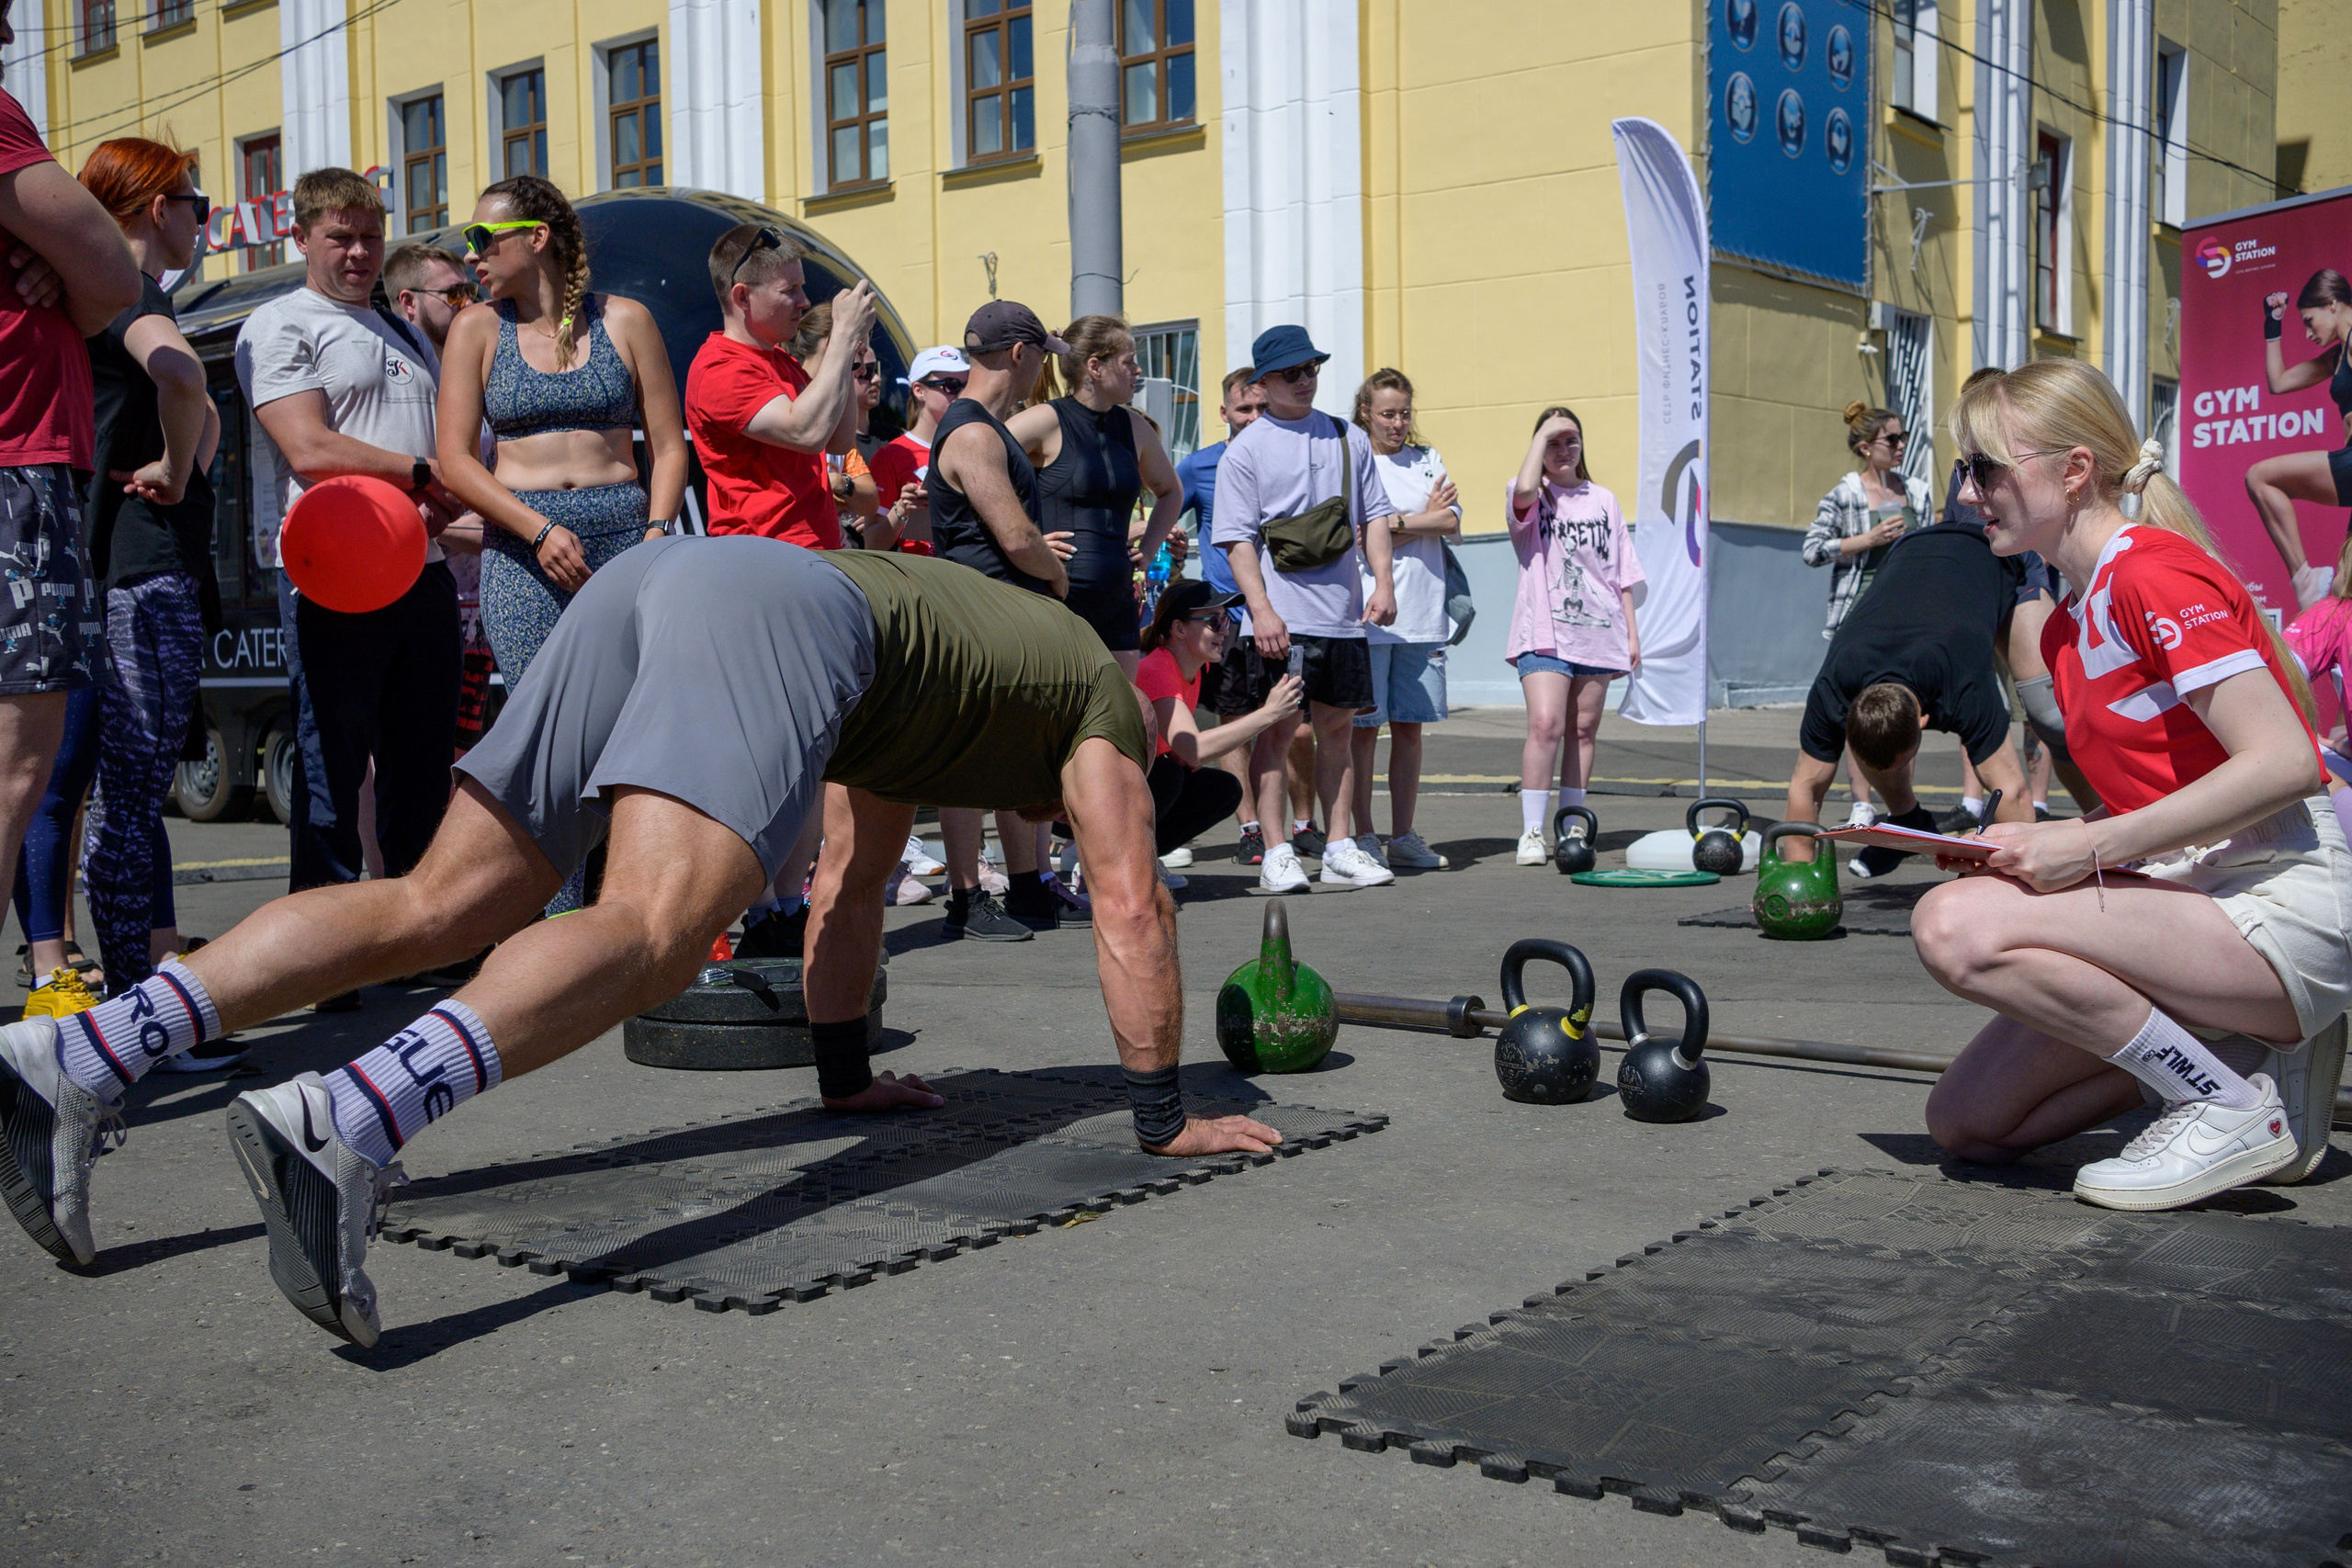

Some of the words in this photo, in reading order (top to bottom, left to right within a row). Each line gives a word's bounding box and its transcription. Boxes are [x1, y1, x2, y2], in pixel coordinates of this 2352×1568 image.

[2234, 239, 2257, 252] GYM
[2234, 245, 2277, 263] STATION
[2193, 385, 2259, 418] GYM
[2193, 408, 2324, 448] STATION
[40, 582, 75, 597] PUMA
[2179, 604, 2206, 619] GYM
[2184, 609, 2229, 630] STATION
[79, 622, 102, 636] PUMA
[119, 985, 170, 1066] RO
